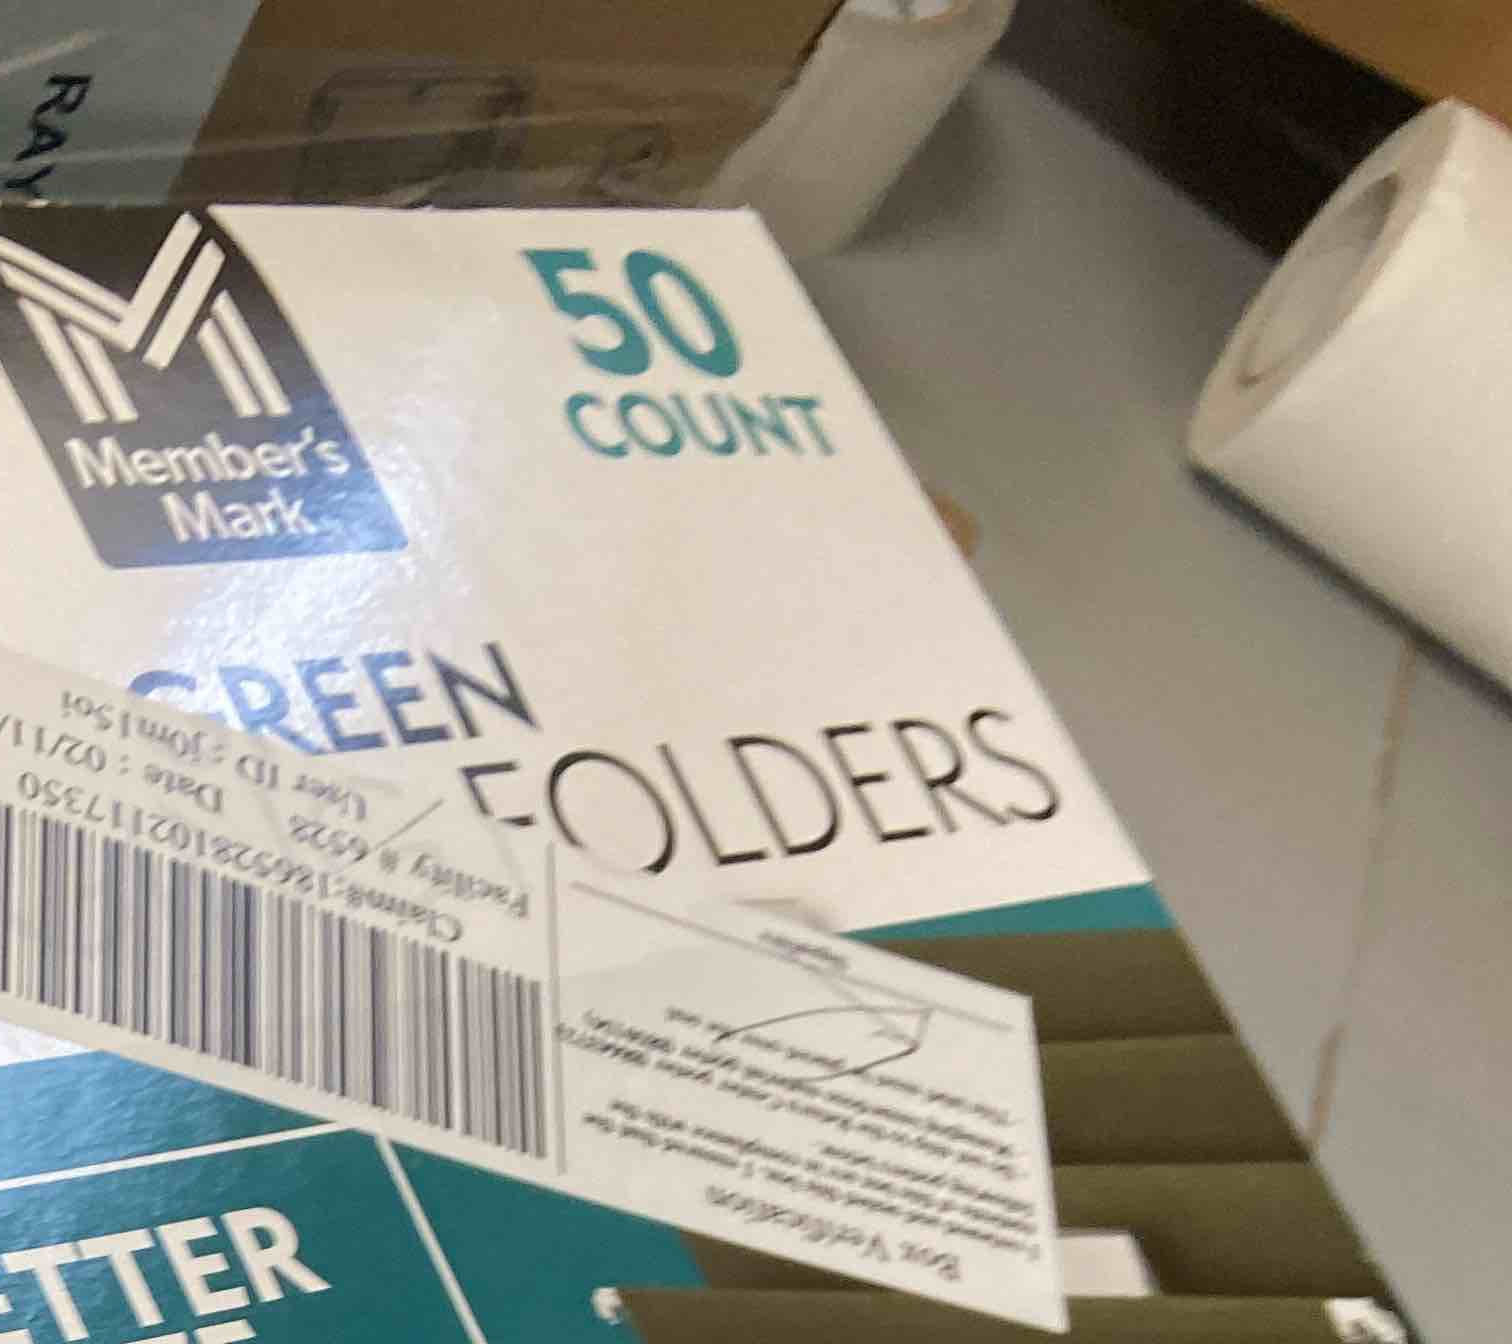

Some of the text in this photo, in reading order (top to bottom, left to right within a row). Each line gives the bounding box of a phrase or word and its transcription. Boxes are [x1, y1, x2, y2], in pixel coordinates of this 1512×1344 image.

[521, 246, 740, 380] 50
[562, 393, 837, 461] COUNT
[63, 426, 351, 489] Member's
[161, 488, 318, 545] Mark
[141, 760, 226, 814] Date
[233, 752, 280, 793] ID
[290, 773, 368, 823] User
[458, 707, 1061, 876] FOLDERS
[289, 813, 369, 864] 6528
[408, 852, 531, 919] Facility
